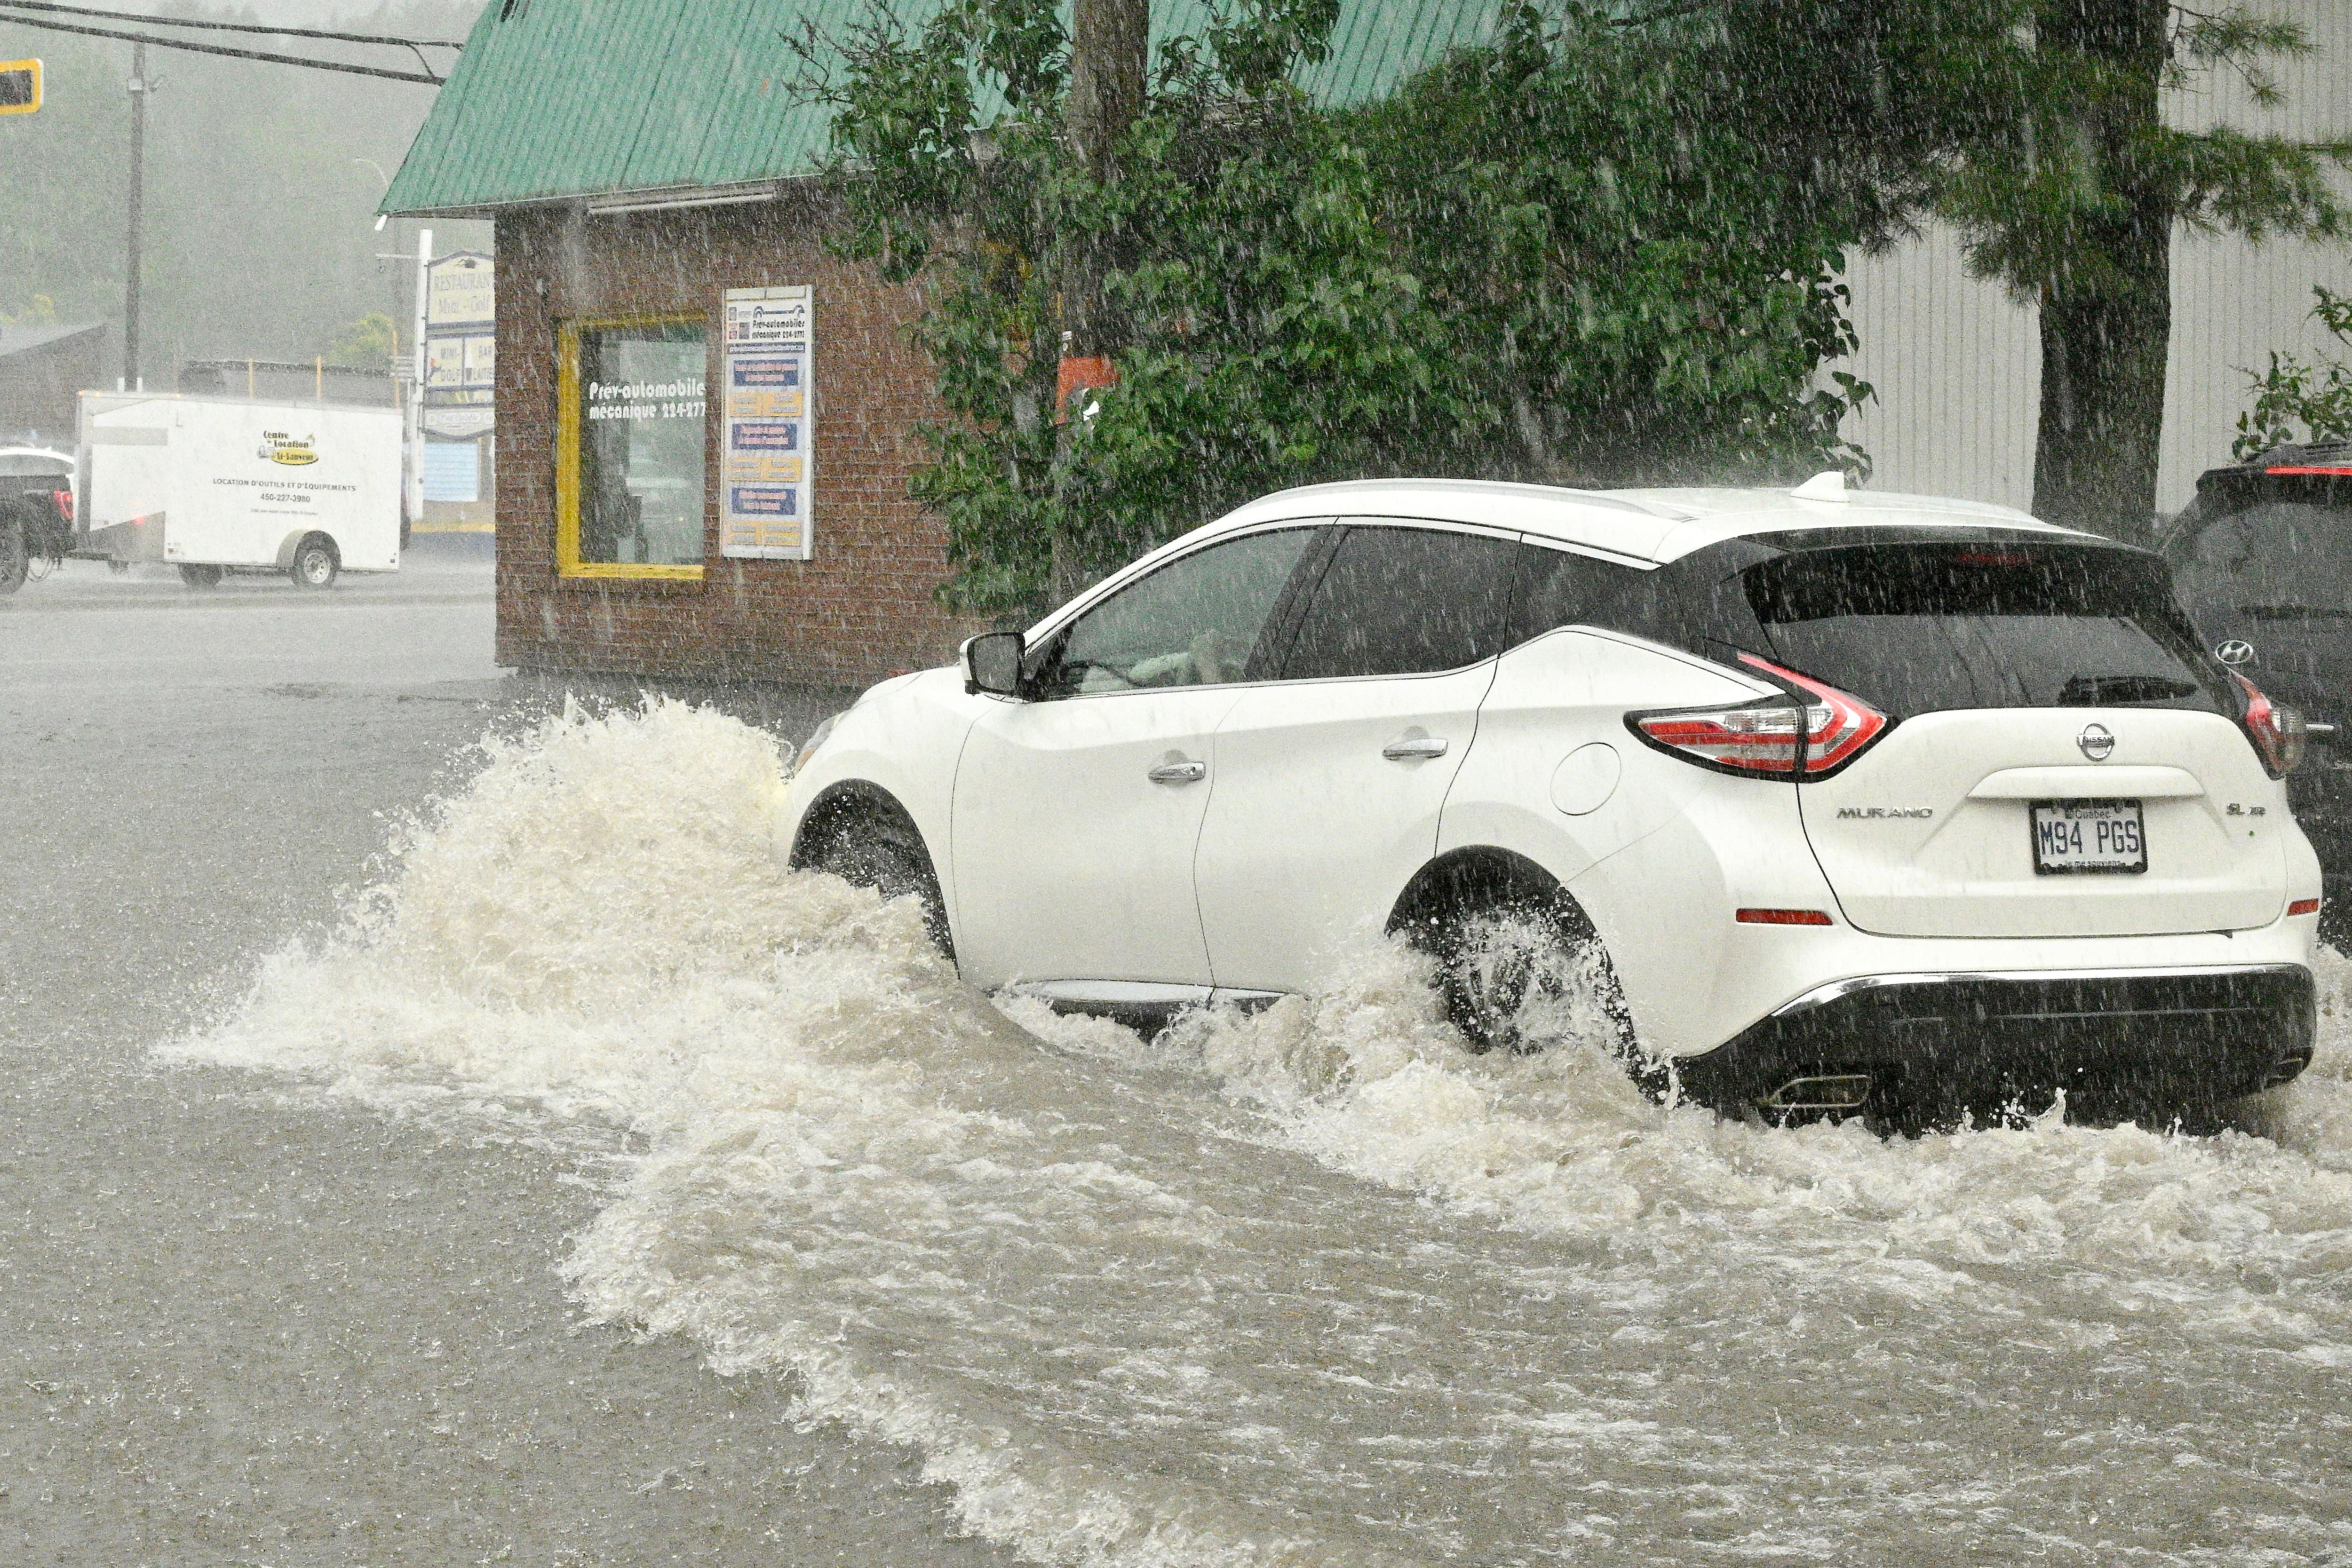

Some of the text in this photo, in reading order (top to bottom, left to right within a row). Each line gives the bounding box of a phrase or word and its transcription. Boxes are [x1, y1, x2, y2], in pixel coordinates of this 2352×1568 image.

[589, 401, 657, 422] mécanique
[263, 430, 289, 439] Centre
[297, 483, 356, 491] D'ÉQUIPEMENTS
[261, 493, 310, 503] 450-227-3980
[1836, 806, 1933, 818] MURANO
[2039, 820, 2139, 855] M94 PGS
